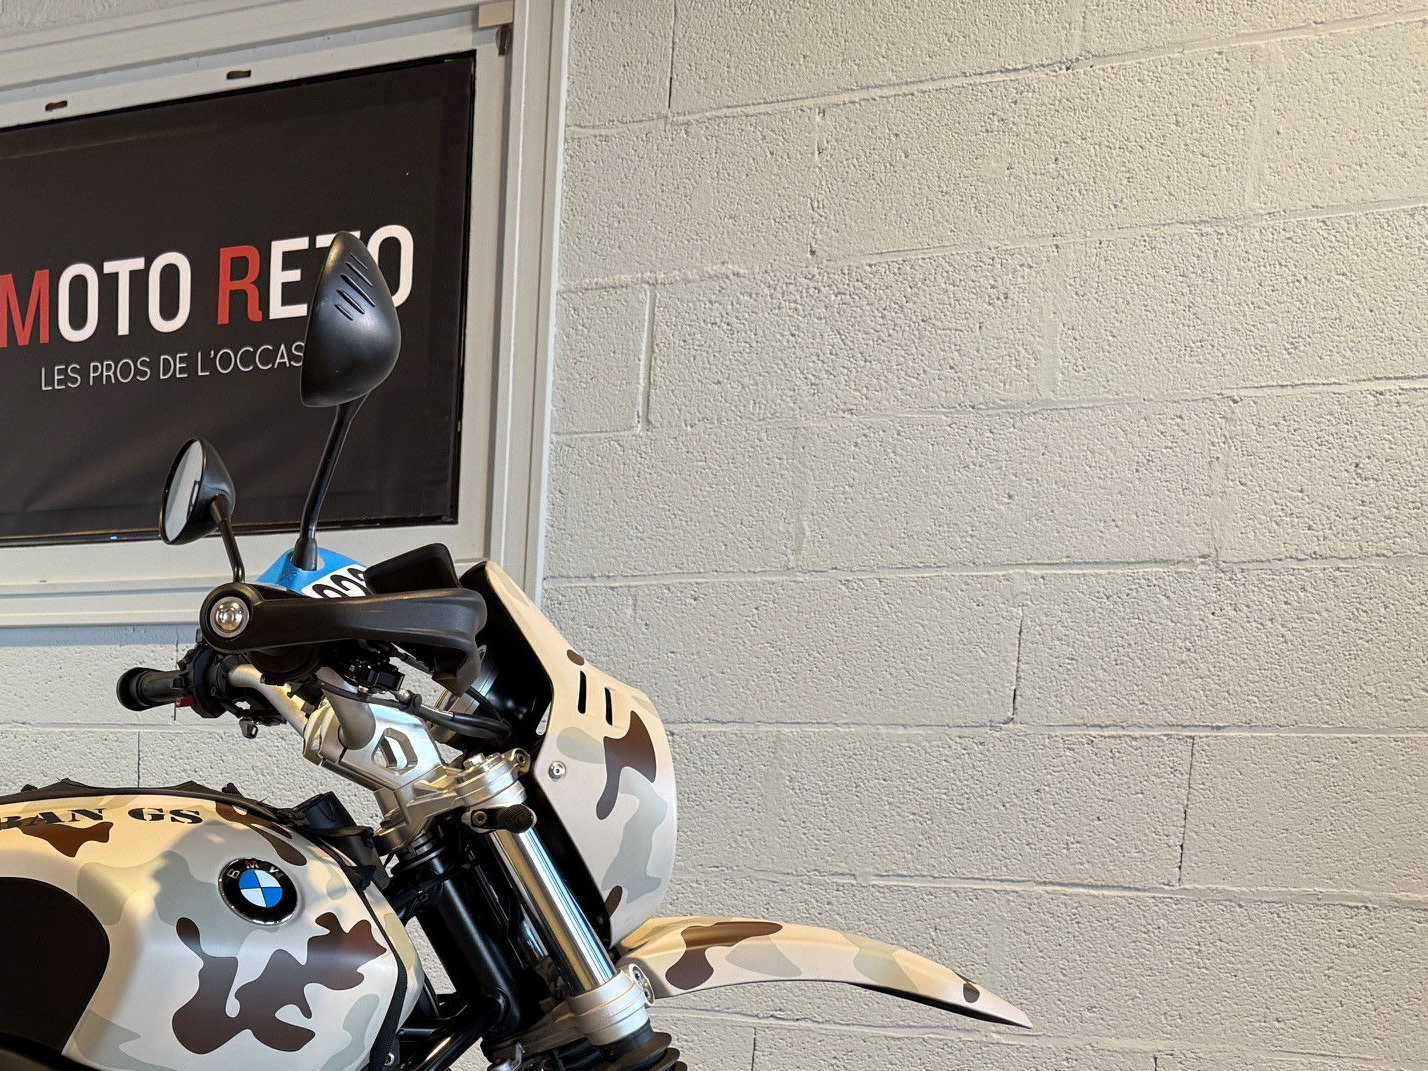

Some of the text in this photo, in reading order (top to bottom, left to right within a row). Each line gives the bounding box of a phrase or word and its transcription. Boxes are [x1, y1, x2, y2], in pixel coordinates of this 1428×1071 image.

[41, 363, 81, 391] LES
[89, 356, 151, 386] PROS
[160, 353, 188, 379] DE
[128, 806, 204, 825] GS
[227, 860, 284, 879] BMW
